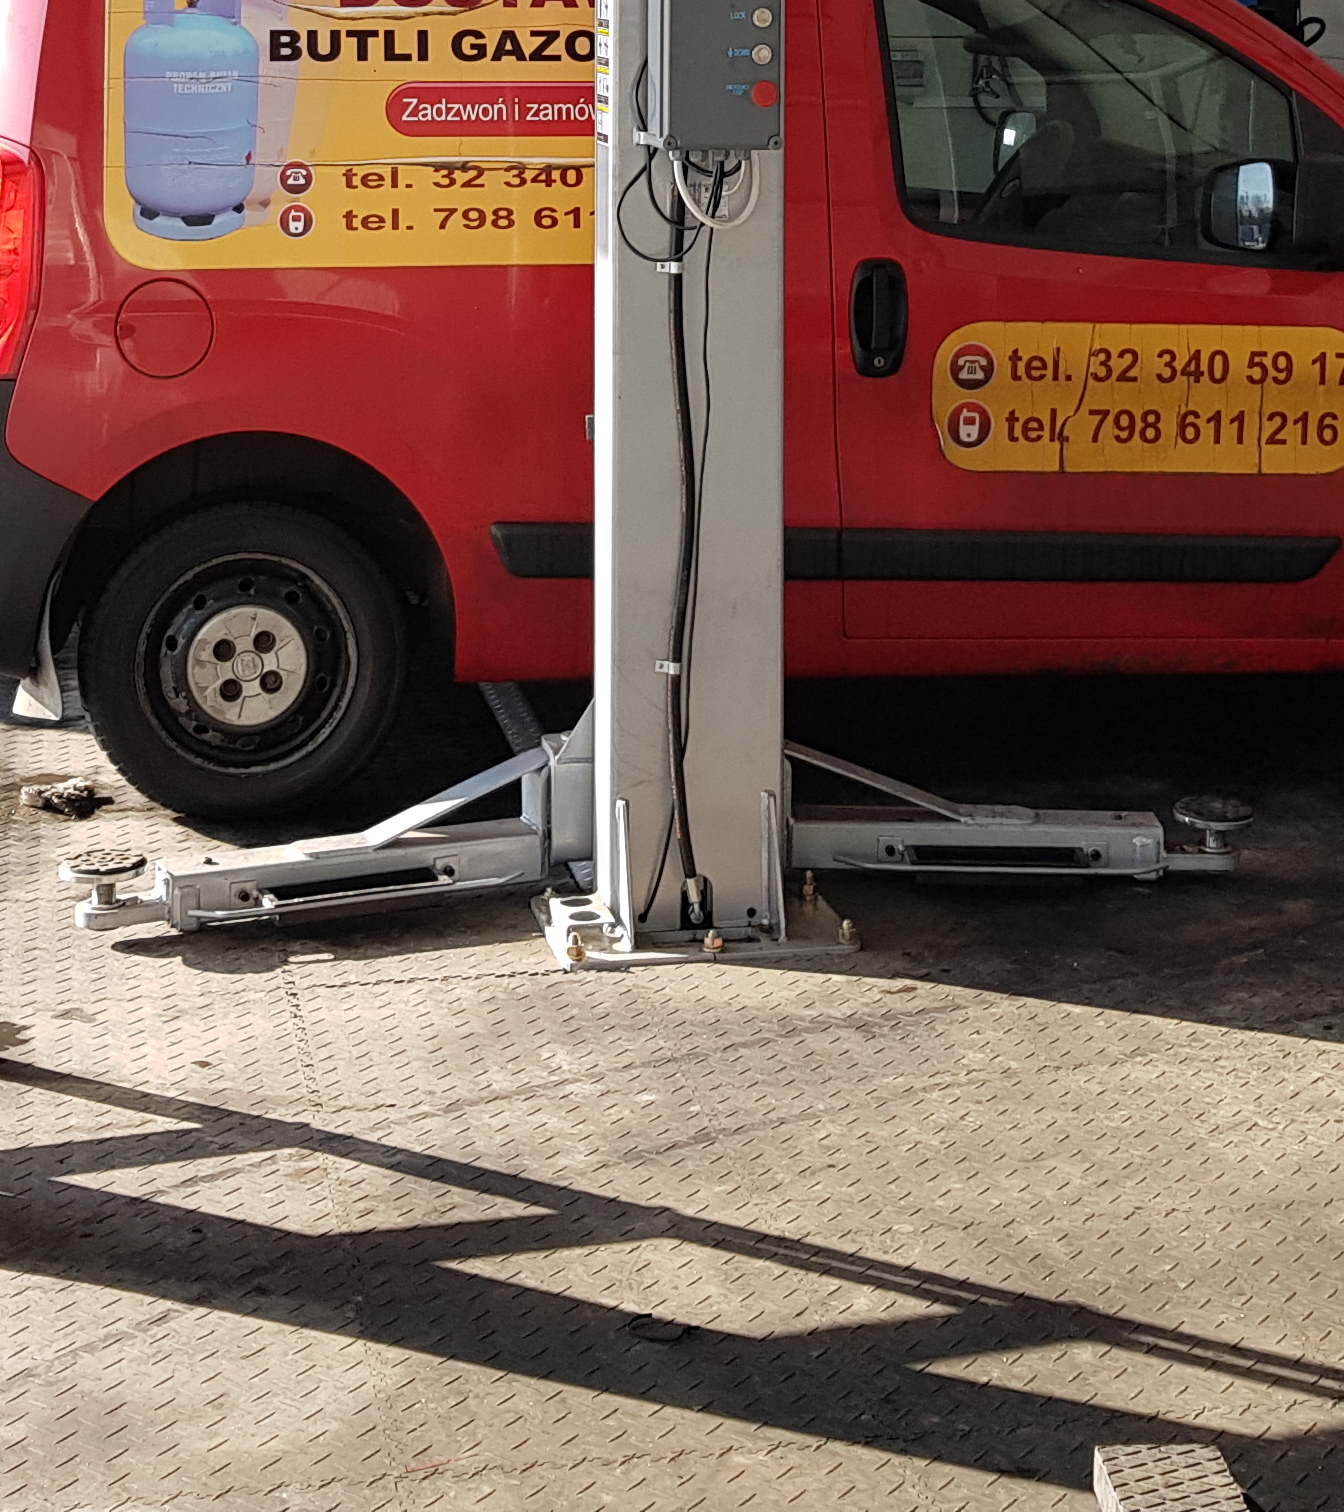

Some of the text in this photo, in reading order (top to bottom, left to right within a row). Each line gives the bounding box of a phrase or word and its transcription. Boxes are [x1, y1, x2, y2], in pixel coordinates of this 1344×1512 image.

[269, 29, 429, 62] BUTLI
[401, 96, 507, 122] Zadzwoń
[514, 97, 520, 121] i
[342, 165, 584, 189] tel. 32 340
[342, 208, 415, 231] tel.
[433, 207, 517, 231] 798
[1008, 347, 1073, 384] tel.
[1090, 348, 1140, 385] 32
[1155, 349, 1230, 386] 340
[1245, 351, 1294, 386] 59
[1005, 408, 1340, 446] tel. 798 611 216
